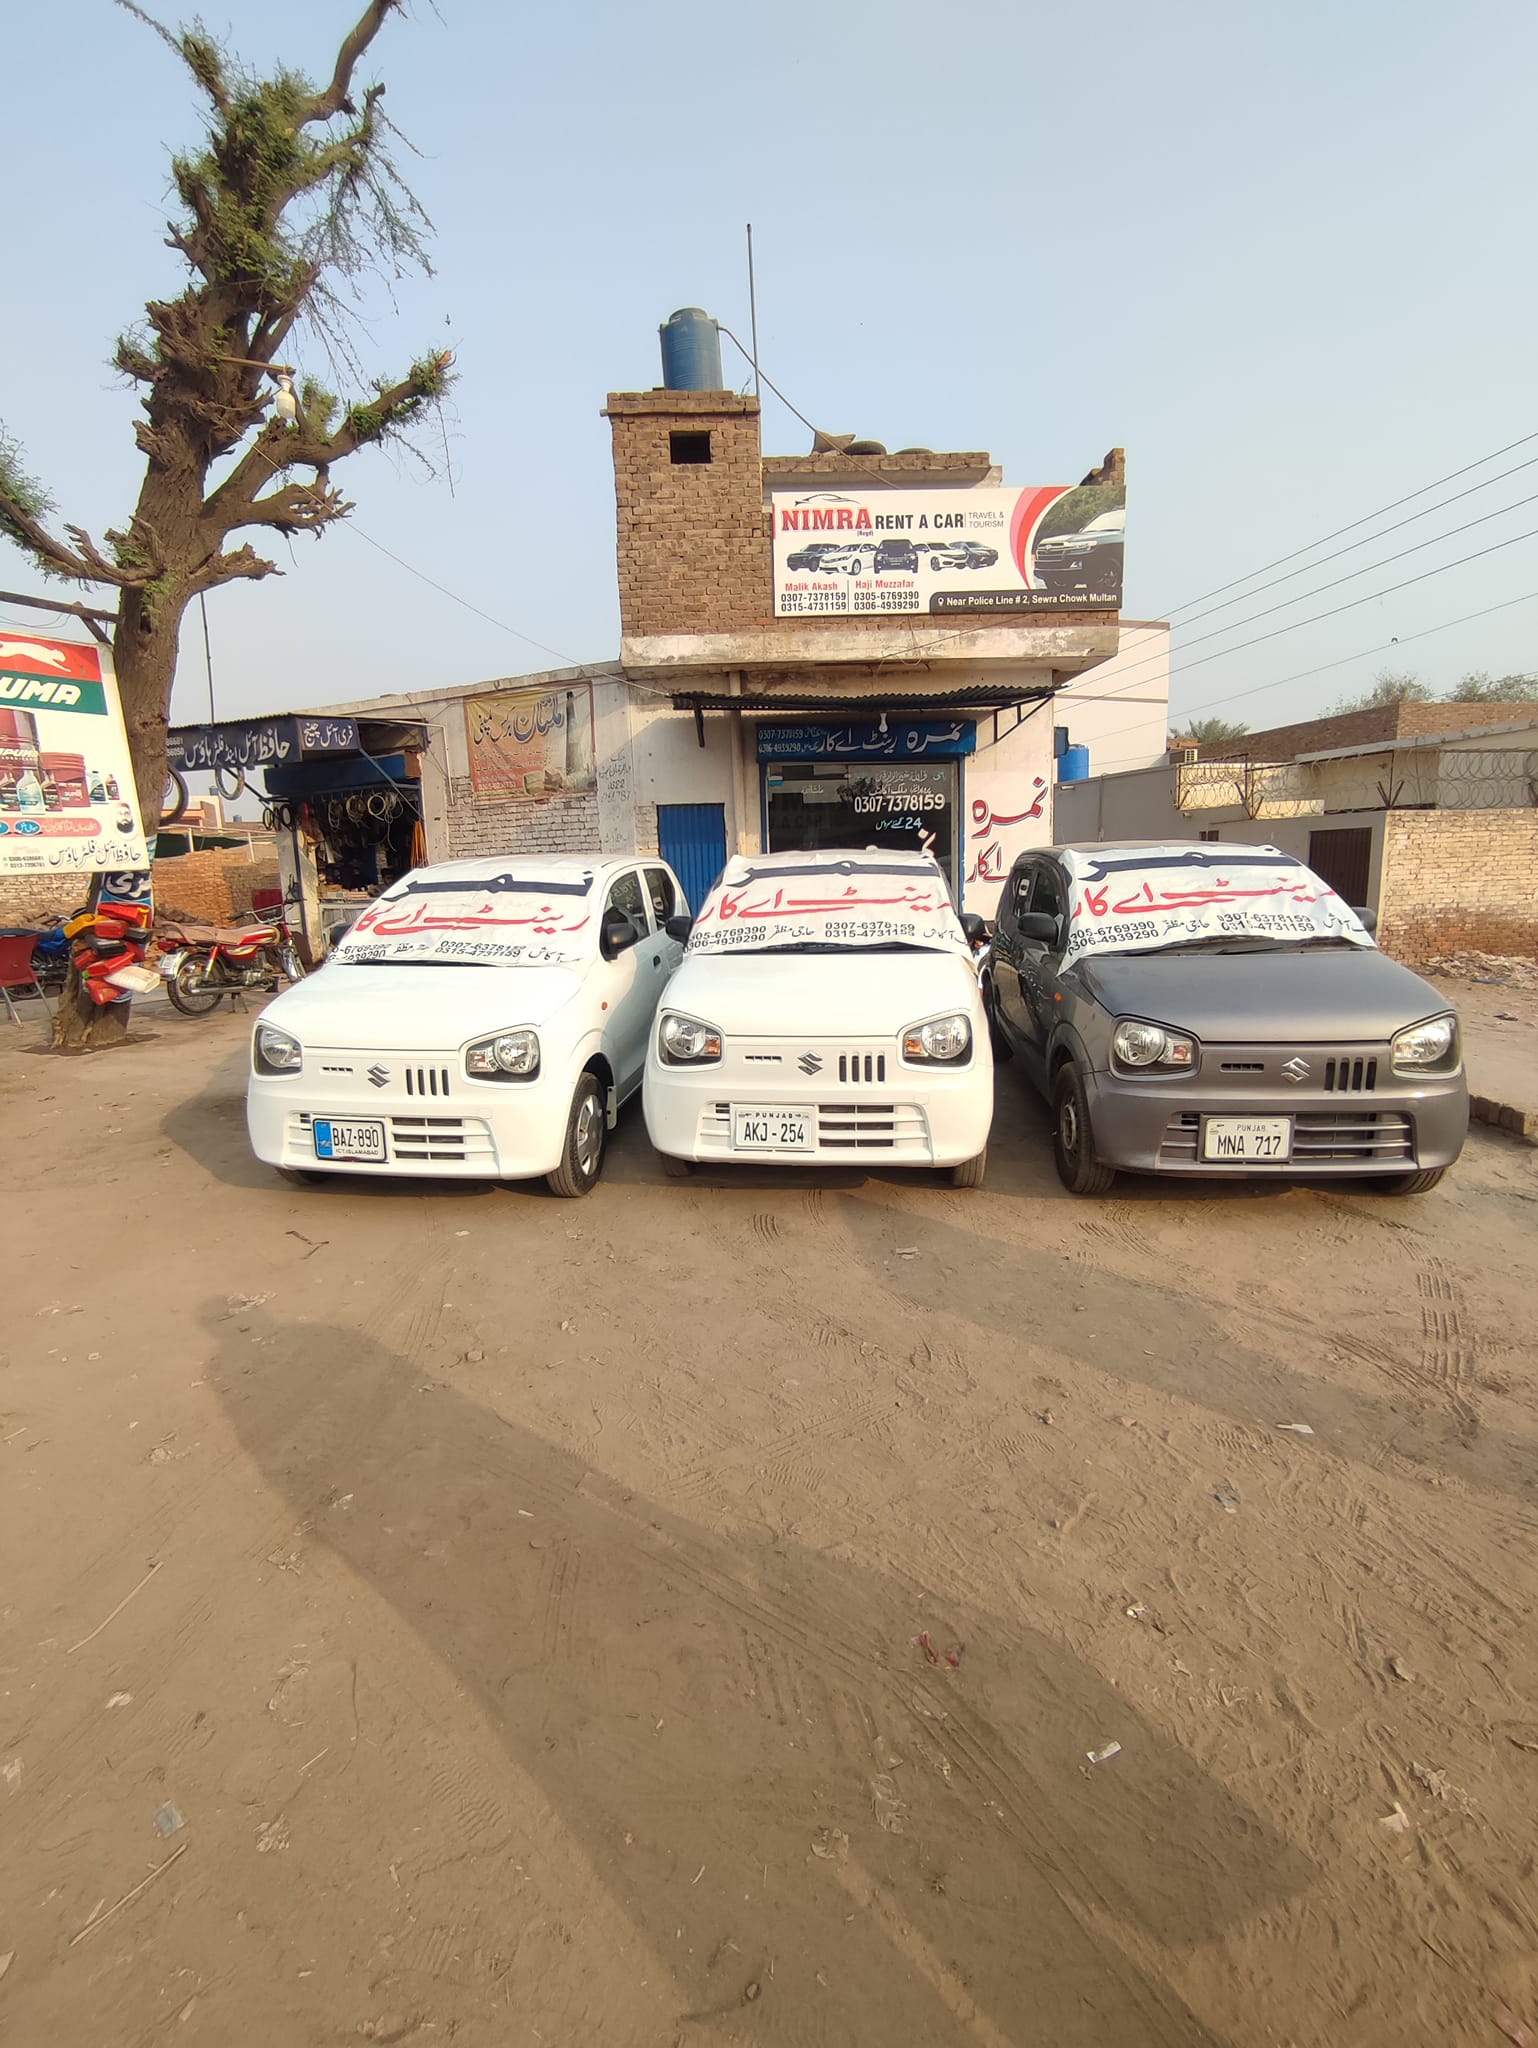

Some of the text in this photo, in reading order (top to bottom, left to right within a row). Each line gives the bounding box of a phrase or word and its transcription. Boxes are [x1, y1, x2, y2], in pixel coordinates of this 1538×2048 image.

[781, 508, 964, 531] NIMRA RENT A CAR
[968, 511, 1004, 519] TRAVEL &
[969, 520, 1004, 528] TOURISM
[785, 582, 838, 592] Malik Akash
[856, 579, 914, 590] Haji Muzzafar
[780, 592, 846, 602] 0307-7378159
[854, 591, 919, 601] 0305-6769390
[946, 597, 967, 606] Near
[968, 596, 995, 606] Police
[996, 595, 1014, 605] Line
[1022, 596, 1030, 605] 2,
[1031, 595, 1058, 604] Sewra
[1059, 594, 1088, 603] Chowk
[1089, 593, 1117, 602] Multan
[780, 601, 846, 612] 0315-4731159
[854, 600, 919, 611] 0306-4939290
[258, 727, 290, 761] حافظ
[854, 793, 946, 813] 0307-7378159
[905, 817, 922, 830] 24
[1236, 1123, 1266, 1132] PUNJAB
[1217, 1135, 1281, 1156] MNA 717
